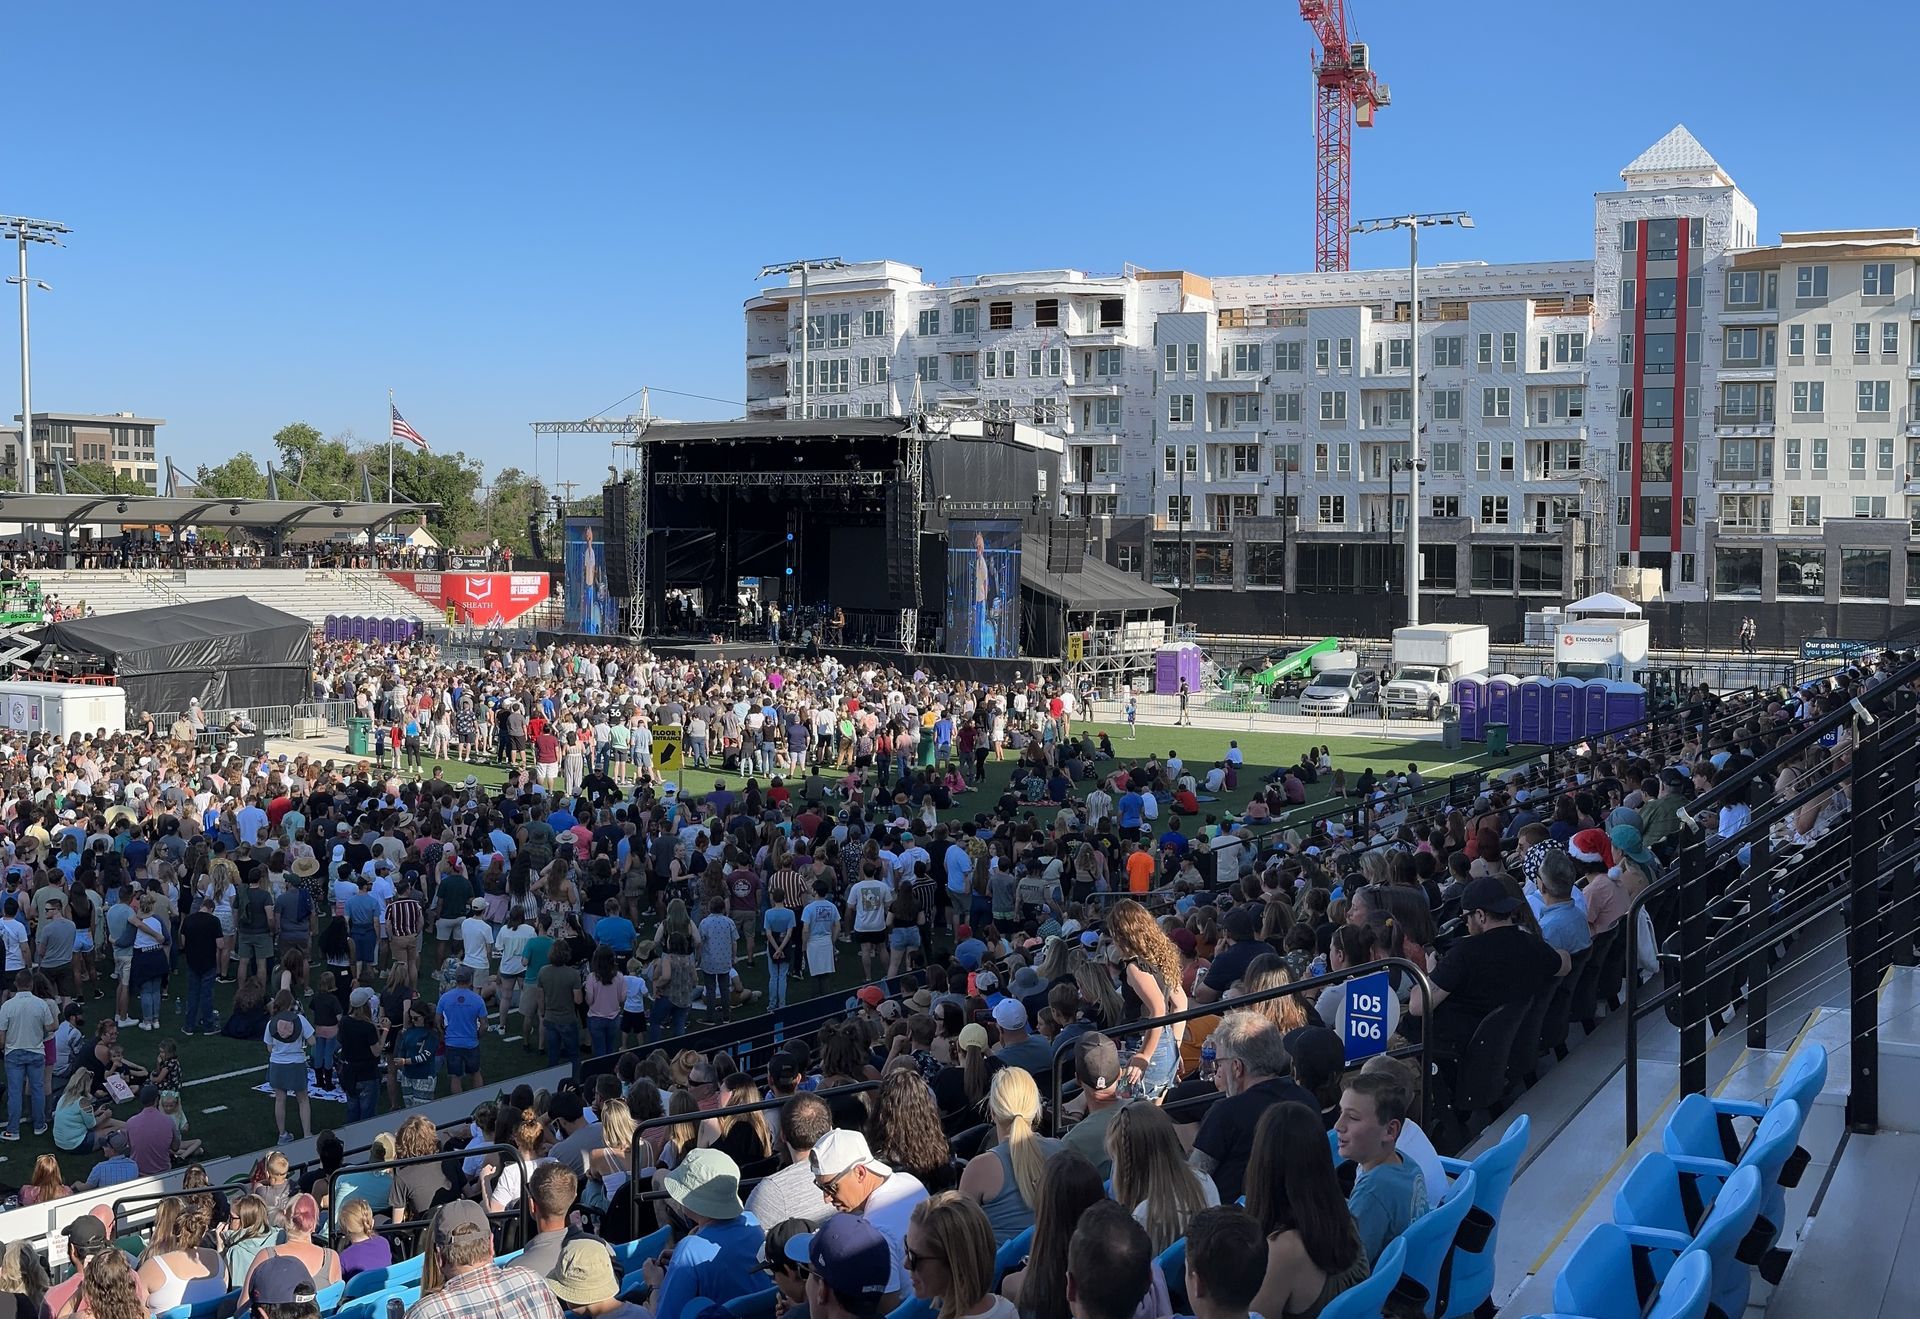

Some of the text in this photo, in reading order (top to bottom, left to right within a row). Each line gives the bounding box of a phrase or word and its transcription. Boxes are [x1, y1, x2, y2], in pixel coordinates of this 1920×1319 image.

[414, 574, 441, 584] UNDERWEAR
[510, 576, 541, 586] UNDERWEAR
[422, 584, 442, 593] LEGENDS
[518, 586, 539, 595] LEGENDS
[610, 708, 622, 716] 36
[1352, 993, 1381, 1013] 105
[1350, 1020, 1381, 1040] 106
